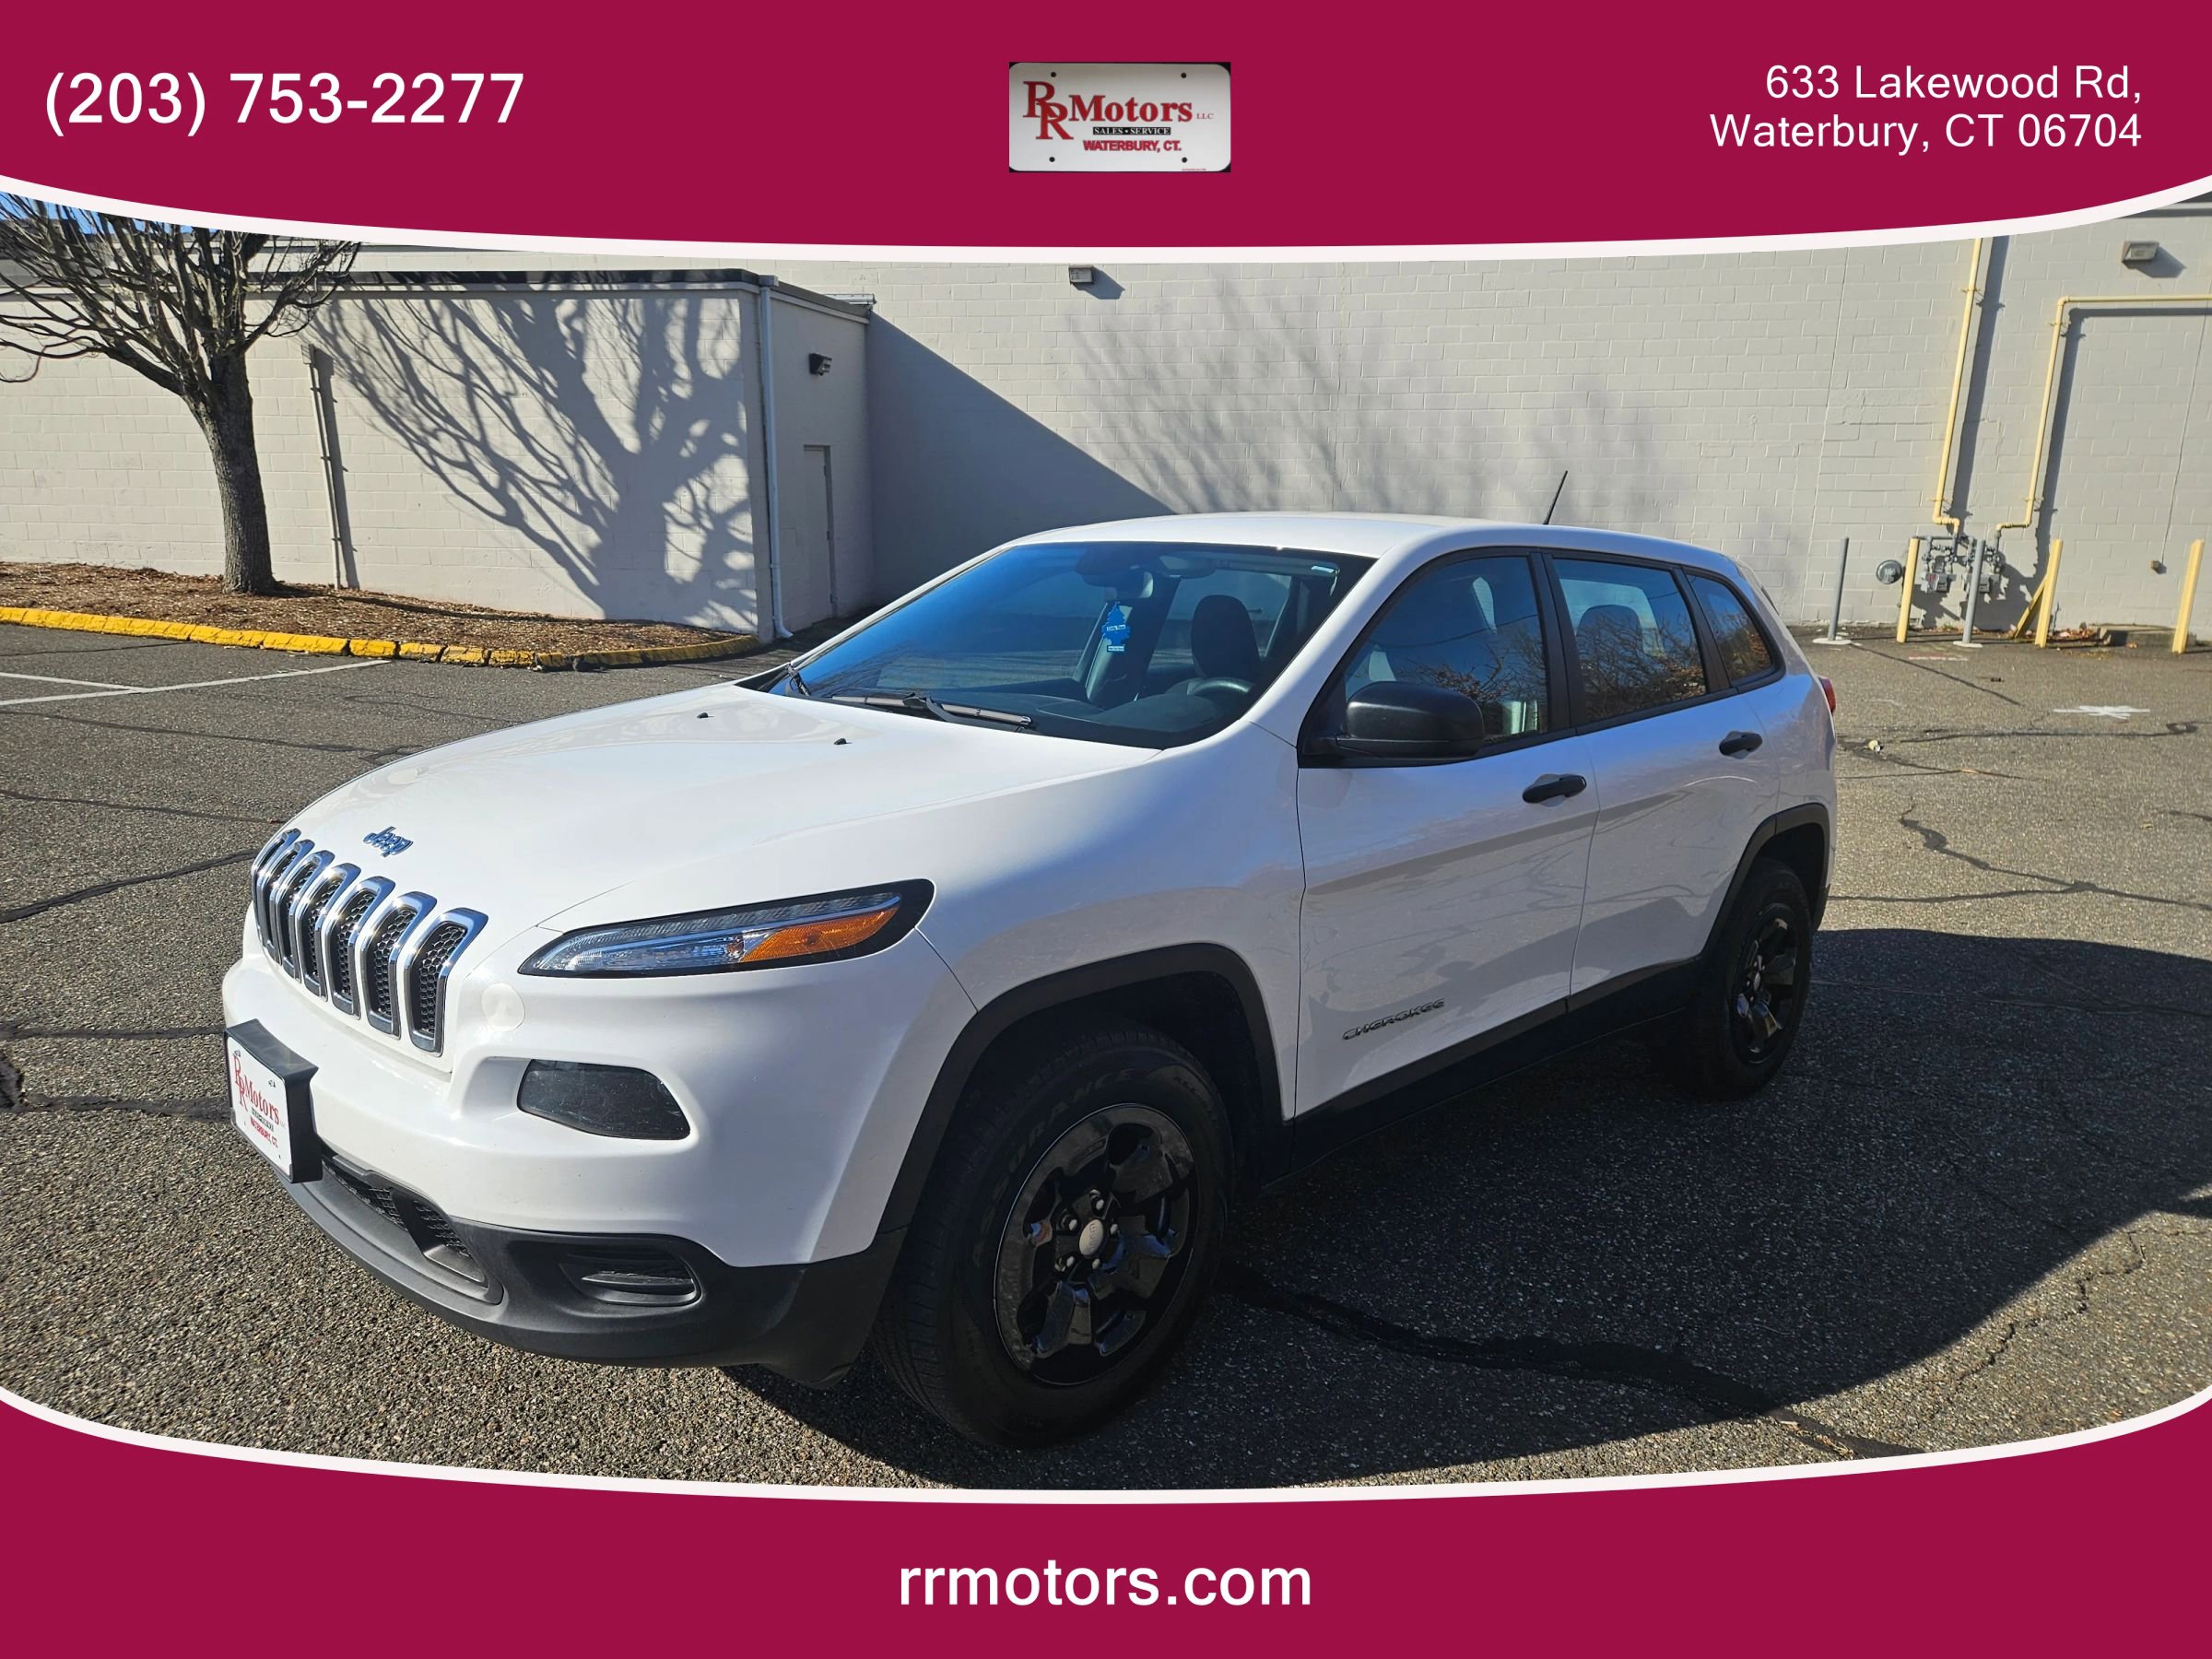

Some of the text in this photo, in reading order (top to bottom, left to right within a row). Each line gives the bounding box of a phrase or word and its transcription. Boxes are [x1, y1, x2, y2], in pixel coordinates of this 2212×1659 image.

[362, 826, 414, 858] Jeep
[1342, 997, 1445, 1041] CHEROKEE
[244, 1075, 279, 1125] Motors
